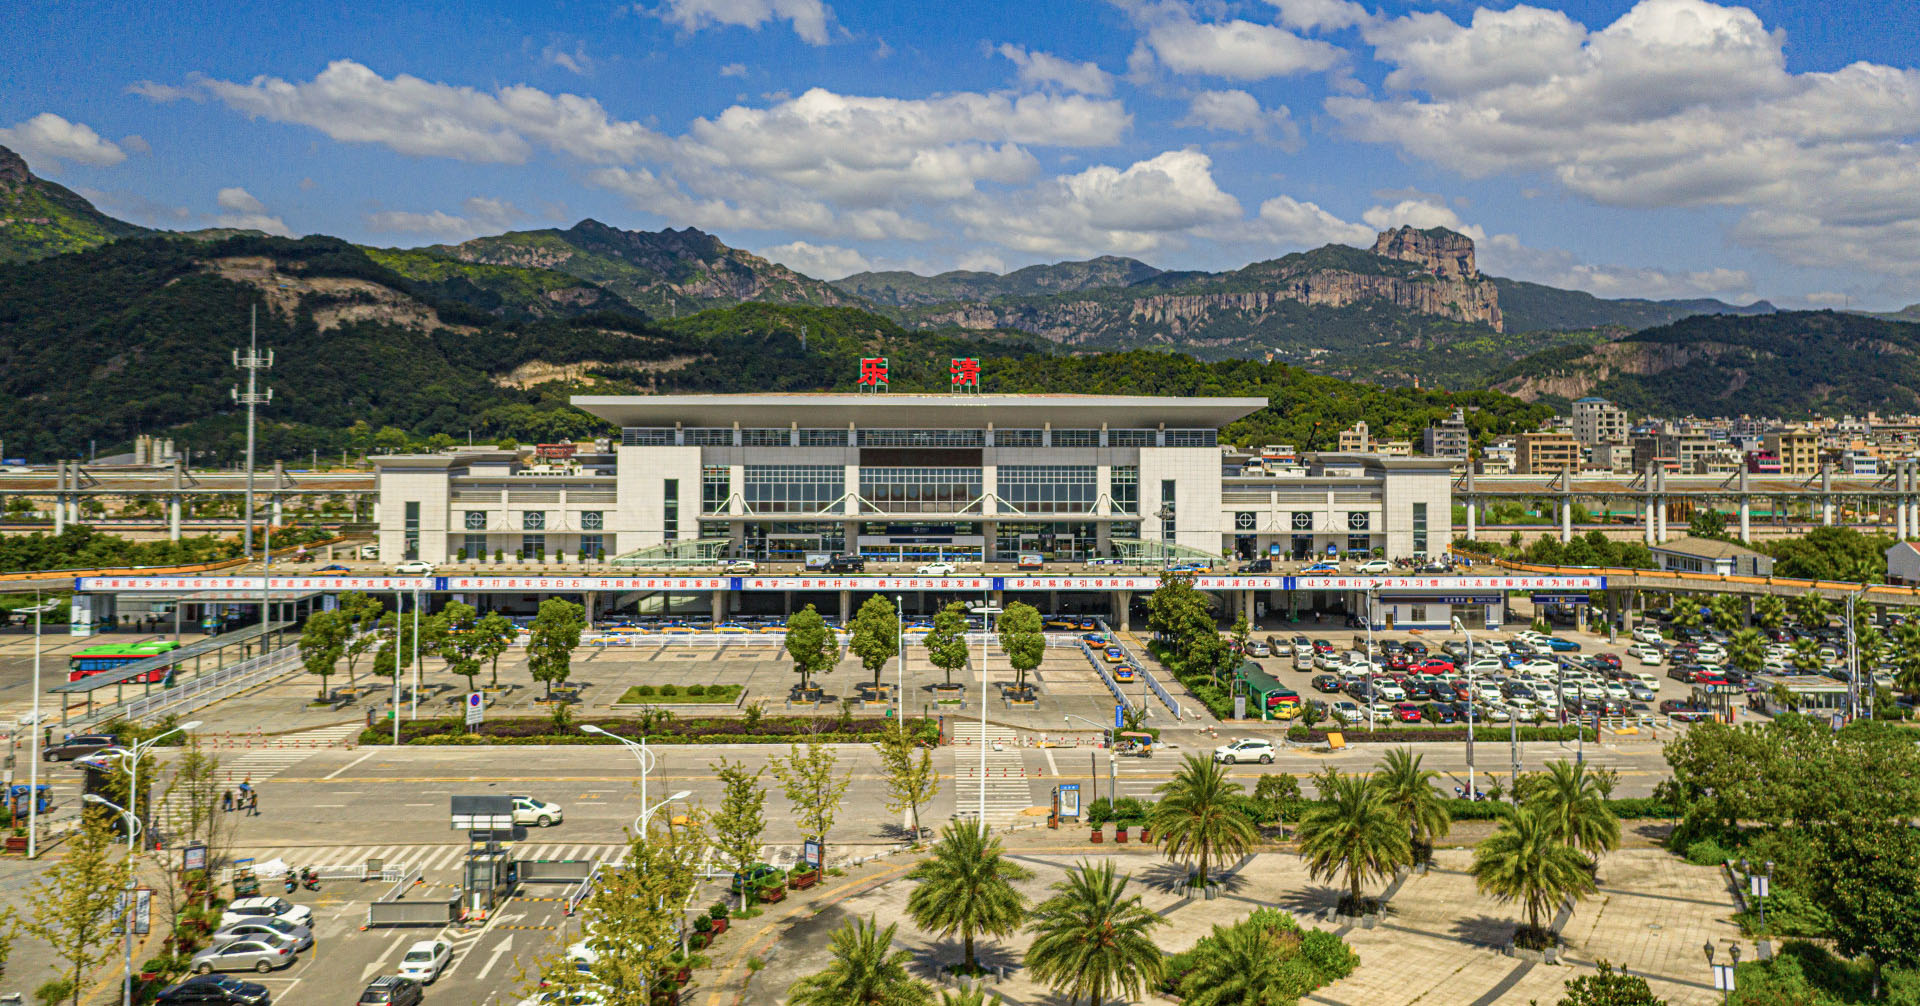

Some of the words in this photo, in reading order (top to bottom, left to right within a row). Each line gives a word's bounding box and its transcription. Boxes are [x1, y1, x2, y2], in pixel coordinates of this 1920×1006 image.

[857, 357, 982, 386] 乐清
[459, 579, 580, 588] 携手打造平安白石
[599, 579, 720, 589] 共同创建和谐家园
[877, 579, 981, 589] 勇于担当促发展
[1016, 579, 1135, 588] 移风易俗引领风尚
[1154, 578, 1272, 588] 文风润泽白石
[1307, 578, 1439, 588] 让文明行为成为习惯
[1459, 578, 1591, 588] 让志愿服务成为时尚
